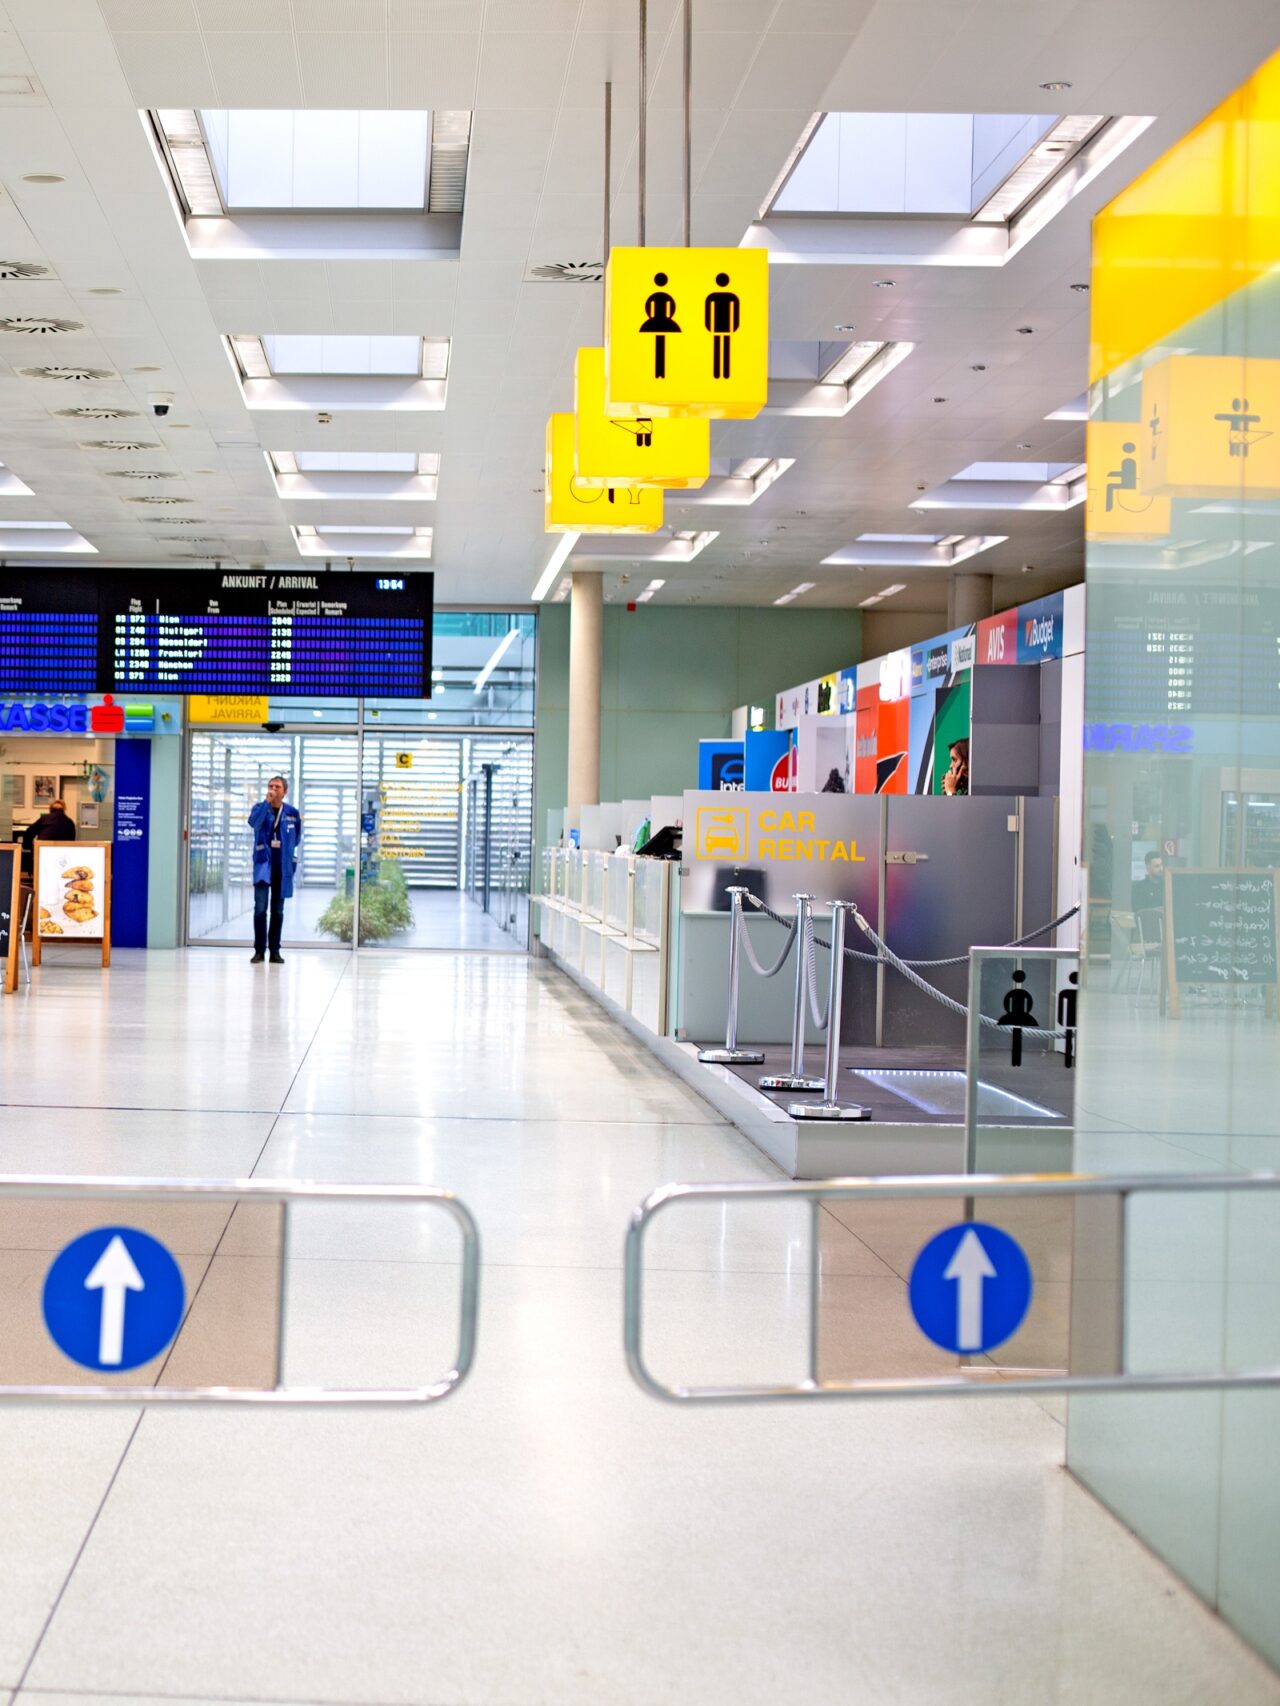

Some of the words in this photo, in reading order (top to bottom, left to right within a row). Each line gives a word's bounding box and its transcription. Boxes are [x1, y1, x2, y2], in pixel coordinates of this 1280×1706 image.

[222, 575, 267, 588] ANKUNFT
[278, 576, 319, 590] ARRIVAL
[986, 624, 1004, 664] AVIS
[1033, 614, 1054, 652] Budget
[400, 754, 409, 765] C
[776, 777, 788, 789] BU
[758, 810, 816, 832] CAR
[758, 838, 866, 862] RENTAL
